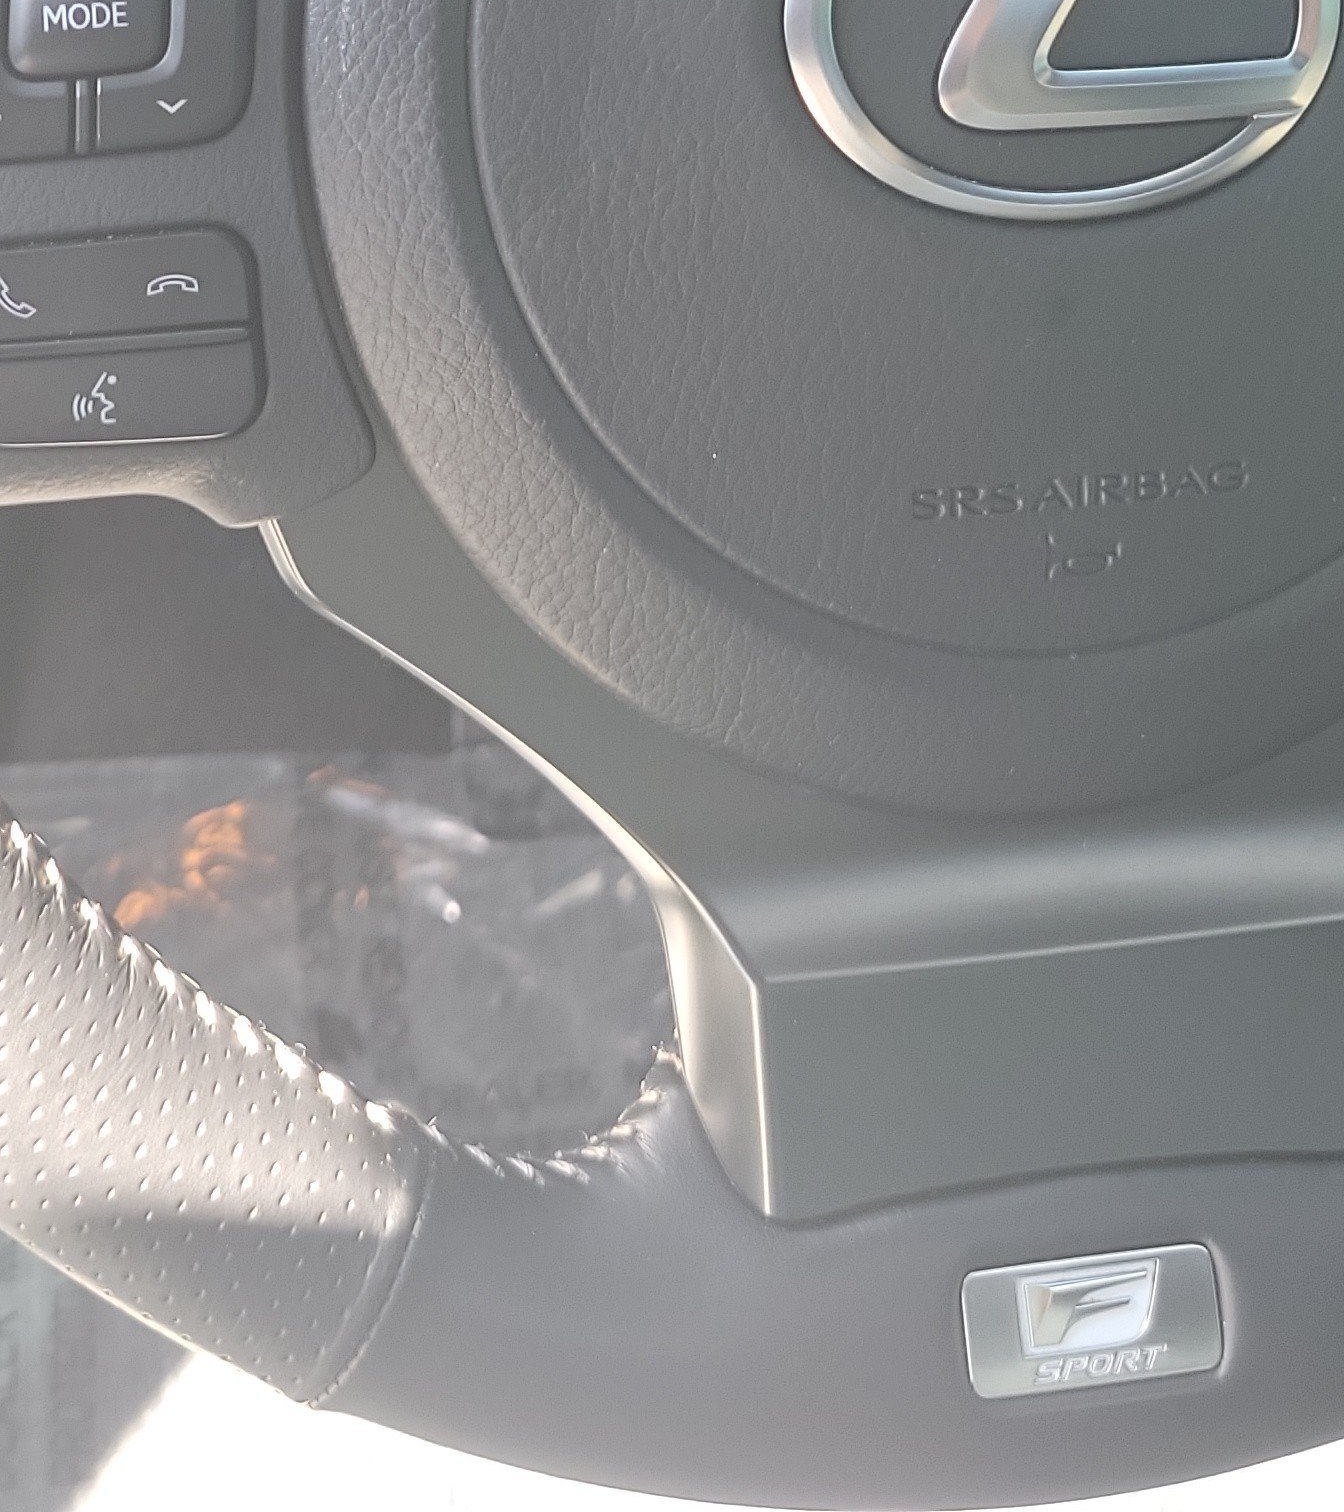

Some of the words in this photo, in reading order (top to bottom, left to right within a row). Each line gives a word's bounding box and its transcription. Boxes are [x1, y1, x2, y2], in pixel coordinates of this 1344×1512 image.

[41, 1, 129, 32] MODE
[910, 484, 1023, 521] SRS
[1036, 460, 1251, 513] AIRBAG
[1035, 1344, 1168, 1385] SPORT
